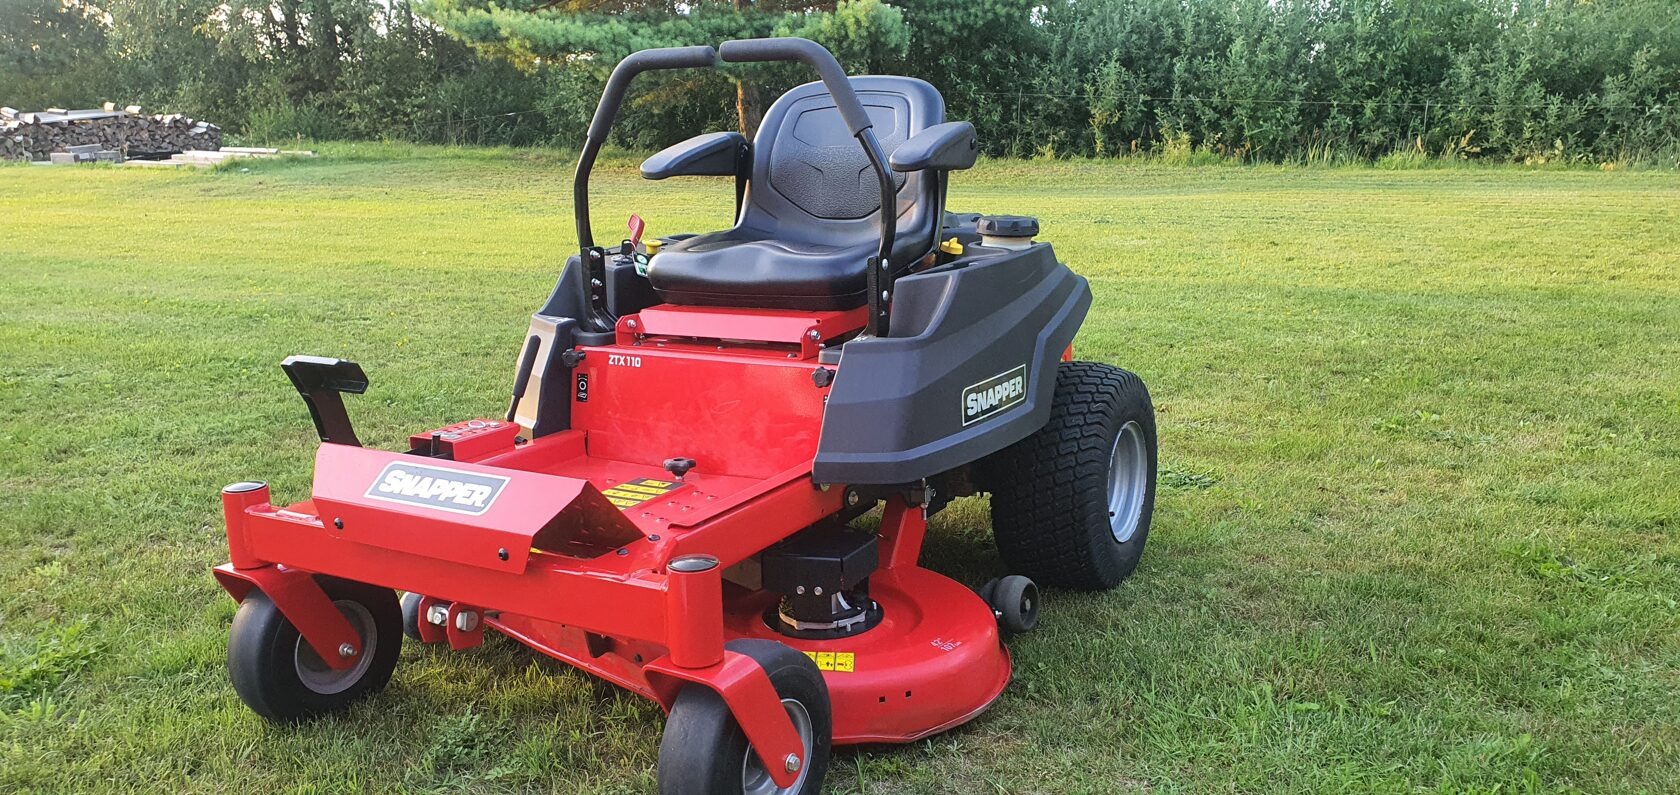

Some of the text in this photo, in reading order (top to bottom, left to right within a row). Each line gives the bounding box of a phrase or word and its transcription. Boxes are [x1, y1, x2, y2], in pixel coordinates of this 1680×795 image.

[608, 354, 642, 368] ZTX110
[966, 375, 1024, 417] SNAPPER
[378, 469, 493, 508] SNAPPER
